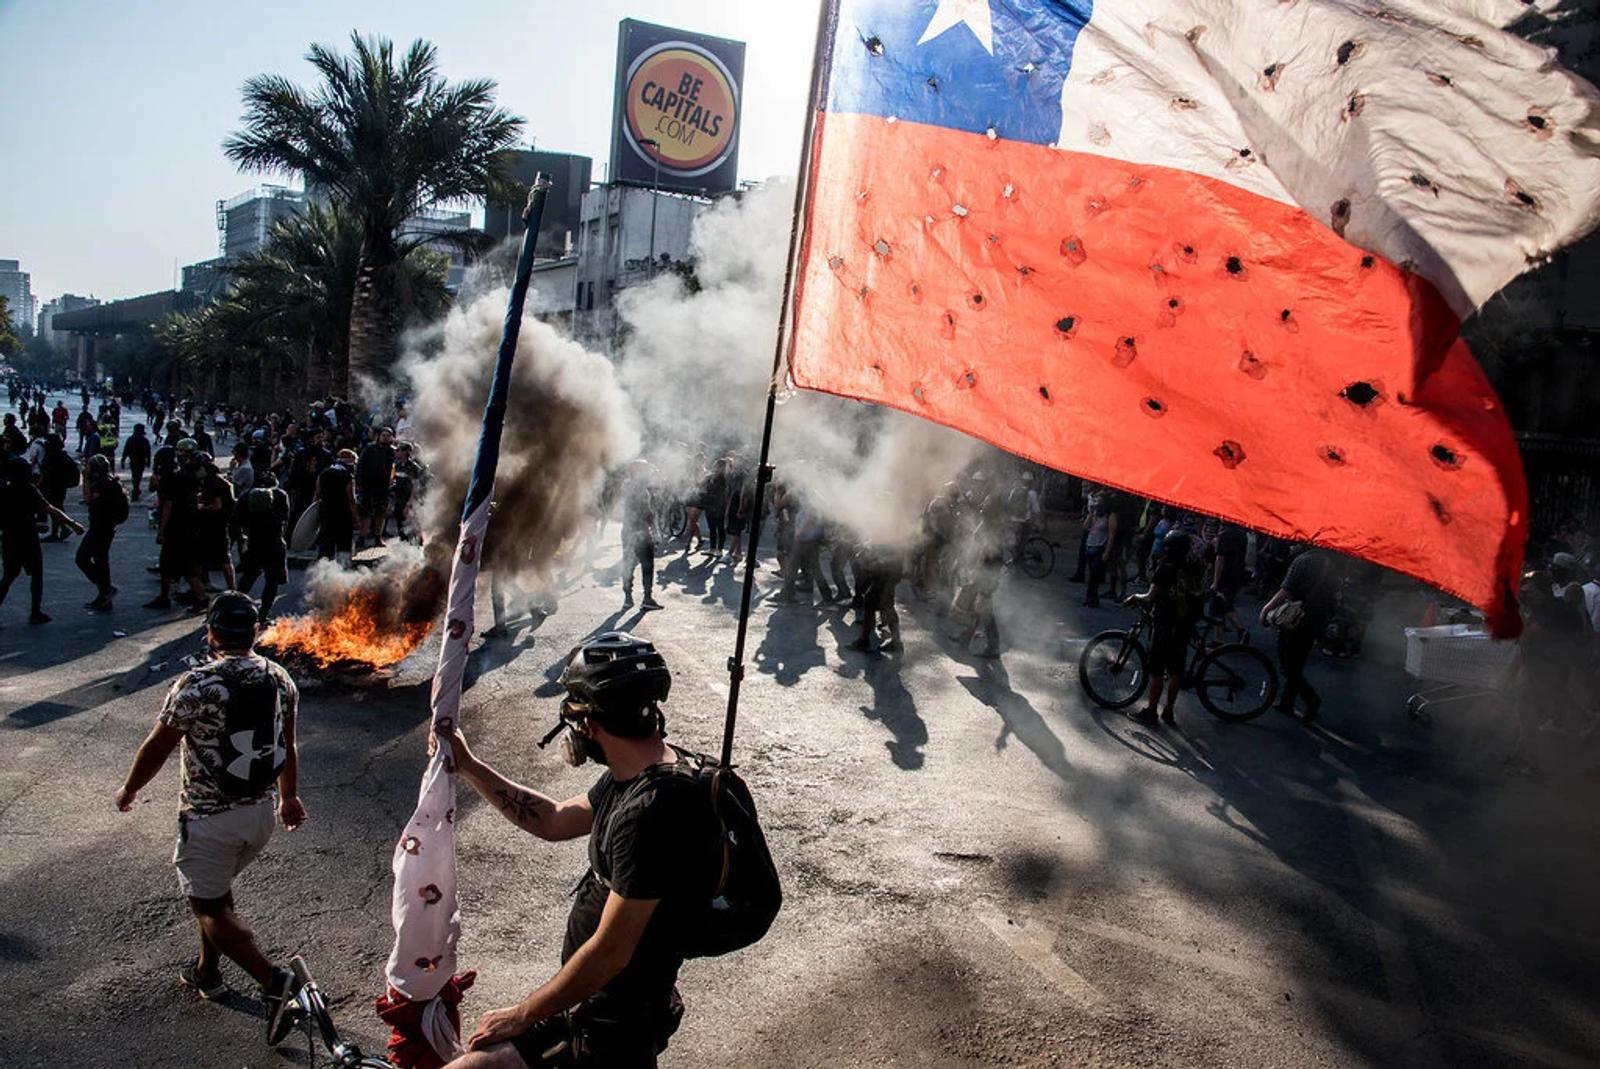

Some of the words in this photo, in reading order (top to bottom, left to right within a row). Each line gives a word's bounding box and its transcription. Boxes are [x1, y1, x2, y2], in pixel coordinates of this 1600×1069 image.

[678, 72, 703, 100] BE
[641, 81, 723, 137] CAPITALS
[654, 115, 696, 146] .COM
